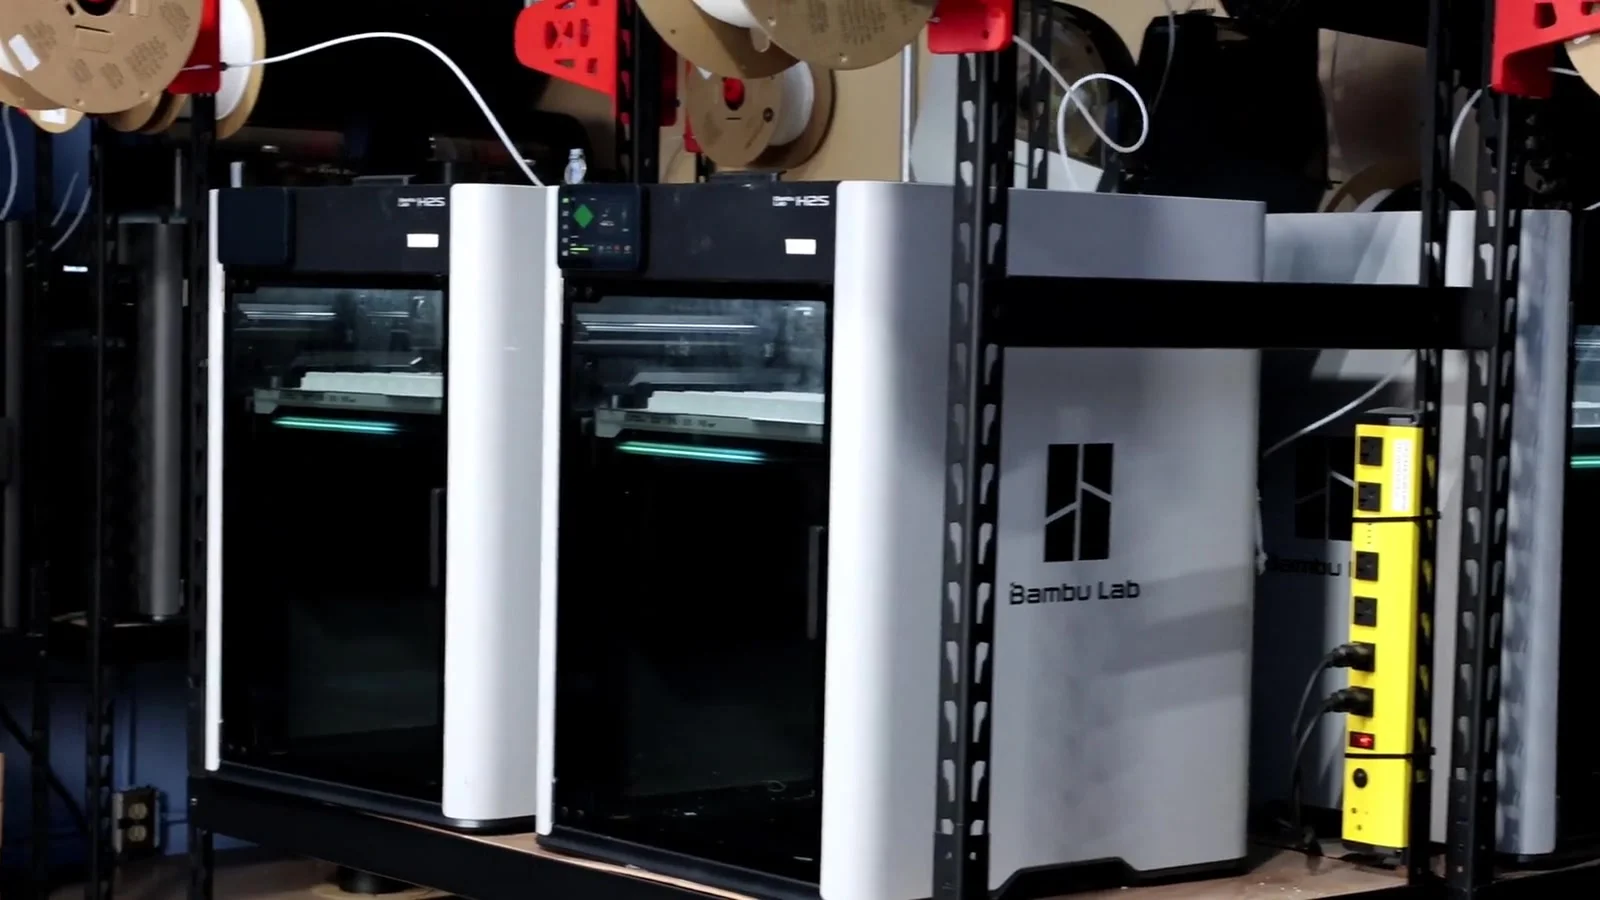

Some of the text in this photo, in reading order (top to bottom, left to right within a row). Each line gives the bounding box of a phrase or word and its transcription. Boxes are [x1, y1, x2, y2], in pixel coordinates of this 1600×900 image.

[416, 197, 446, 207] H2S
[795, 195, 830, 206] H2S
[1009, 579, 1140, 605] Bambu Lab
